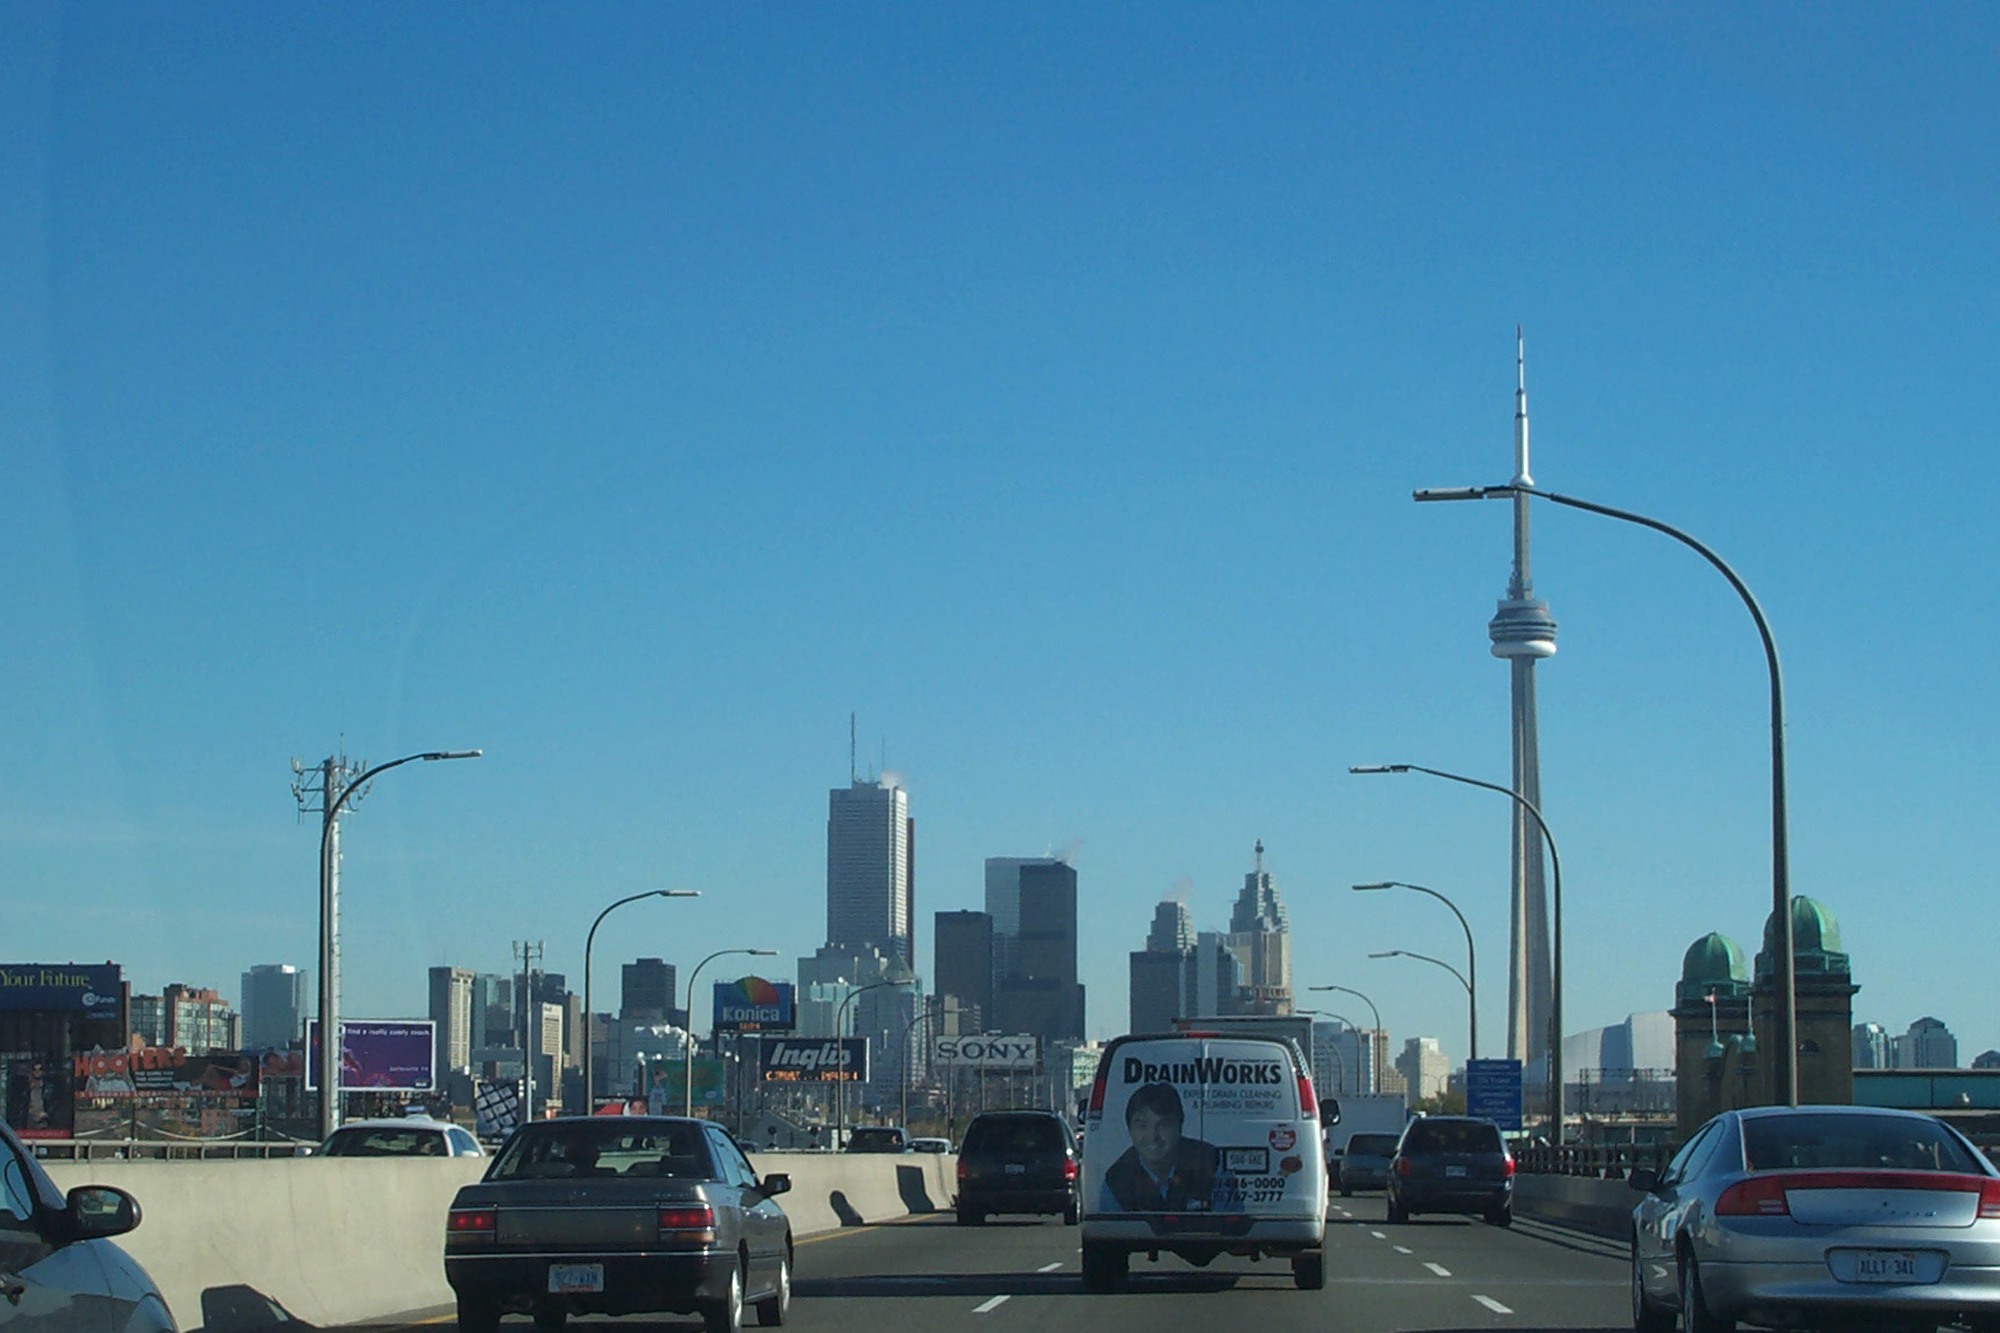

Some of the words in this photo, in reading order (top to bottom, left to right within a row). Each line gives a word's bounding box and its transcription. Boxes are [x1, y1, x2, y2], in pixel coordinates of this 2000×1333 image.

[0, 970, 35, 986] Your
[40, 970, 90, 986] Future
[722, 1005, 780, 1021] Konica
[769, 1042, 851, 1070] Inglis
[937, 1041, 1034, 1060] SONY
[73, 1048, 187, 1078] HOOTERS
[1182, 1089, 1210, 1100] EXPET
